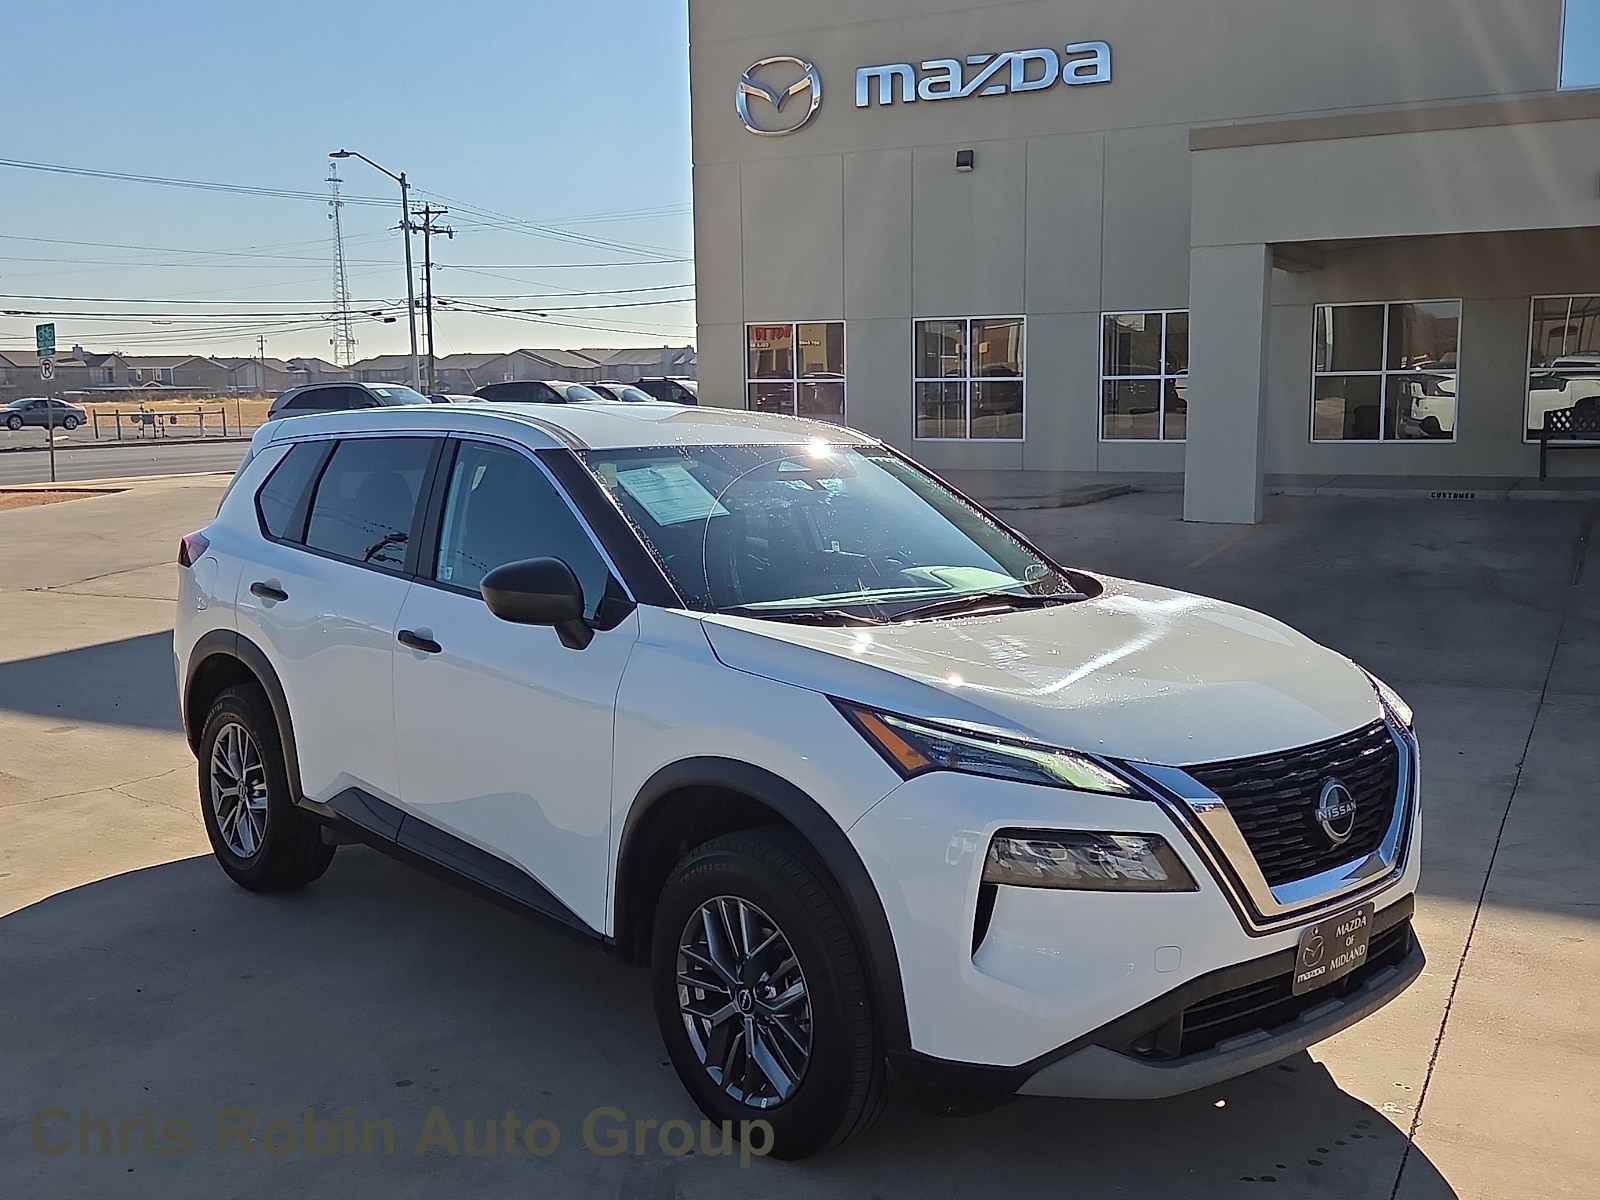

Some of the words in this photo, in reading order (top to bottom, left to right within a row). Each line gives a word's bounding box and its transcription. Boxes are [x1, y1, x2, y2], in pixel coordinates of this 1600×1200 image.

[1318, 802, 1356, 820] NISSAN
[1335, 915, 1367, 938] MAZDA
[1345, 935, 1355, 946] OF
[1329, 944, 1366, 971] MIDLAND
